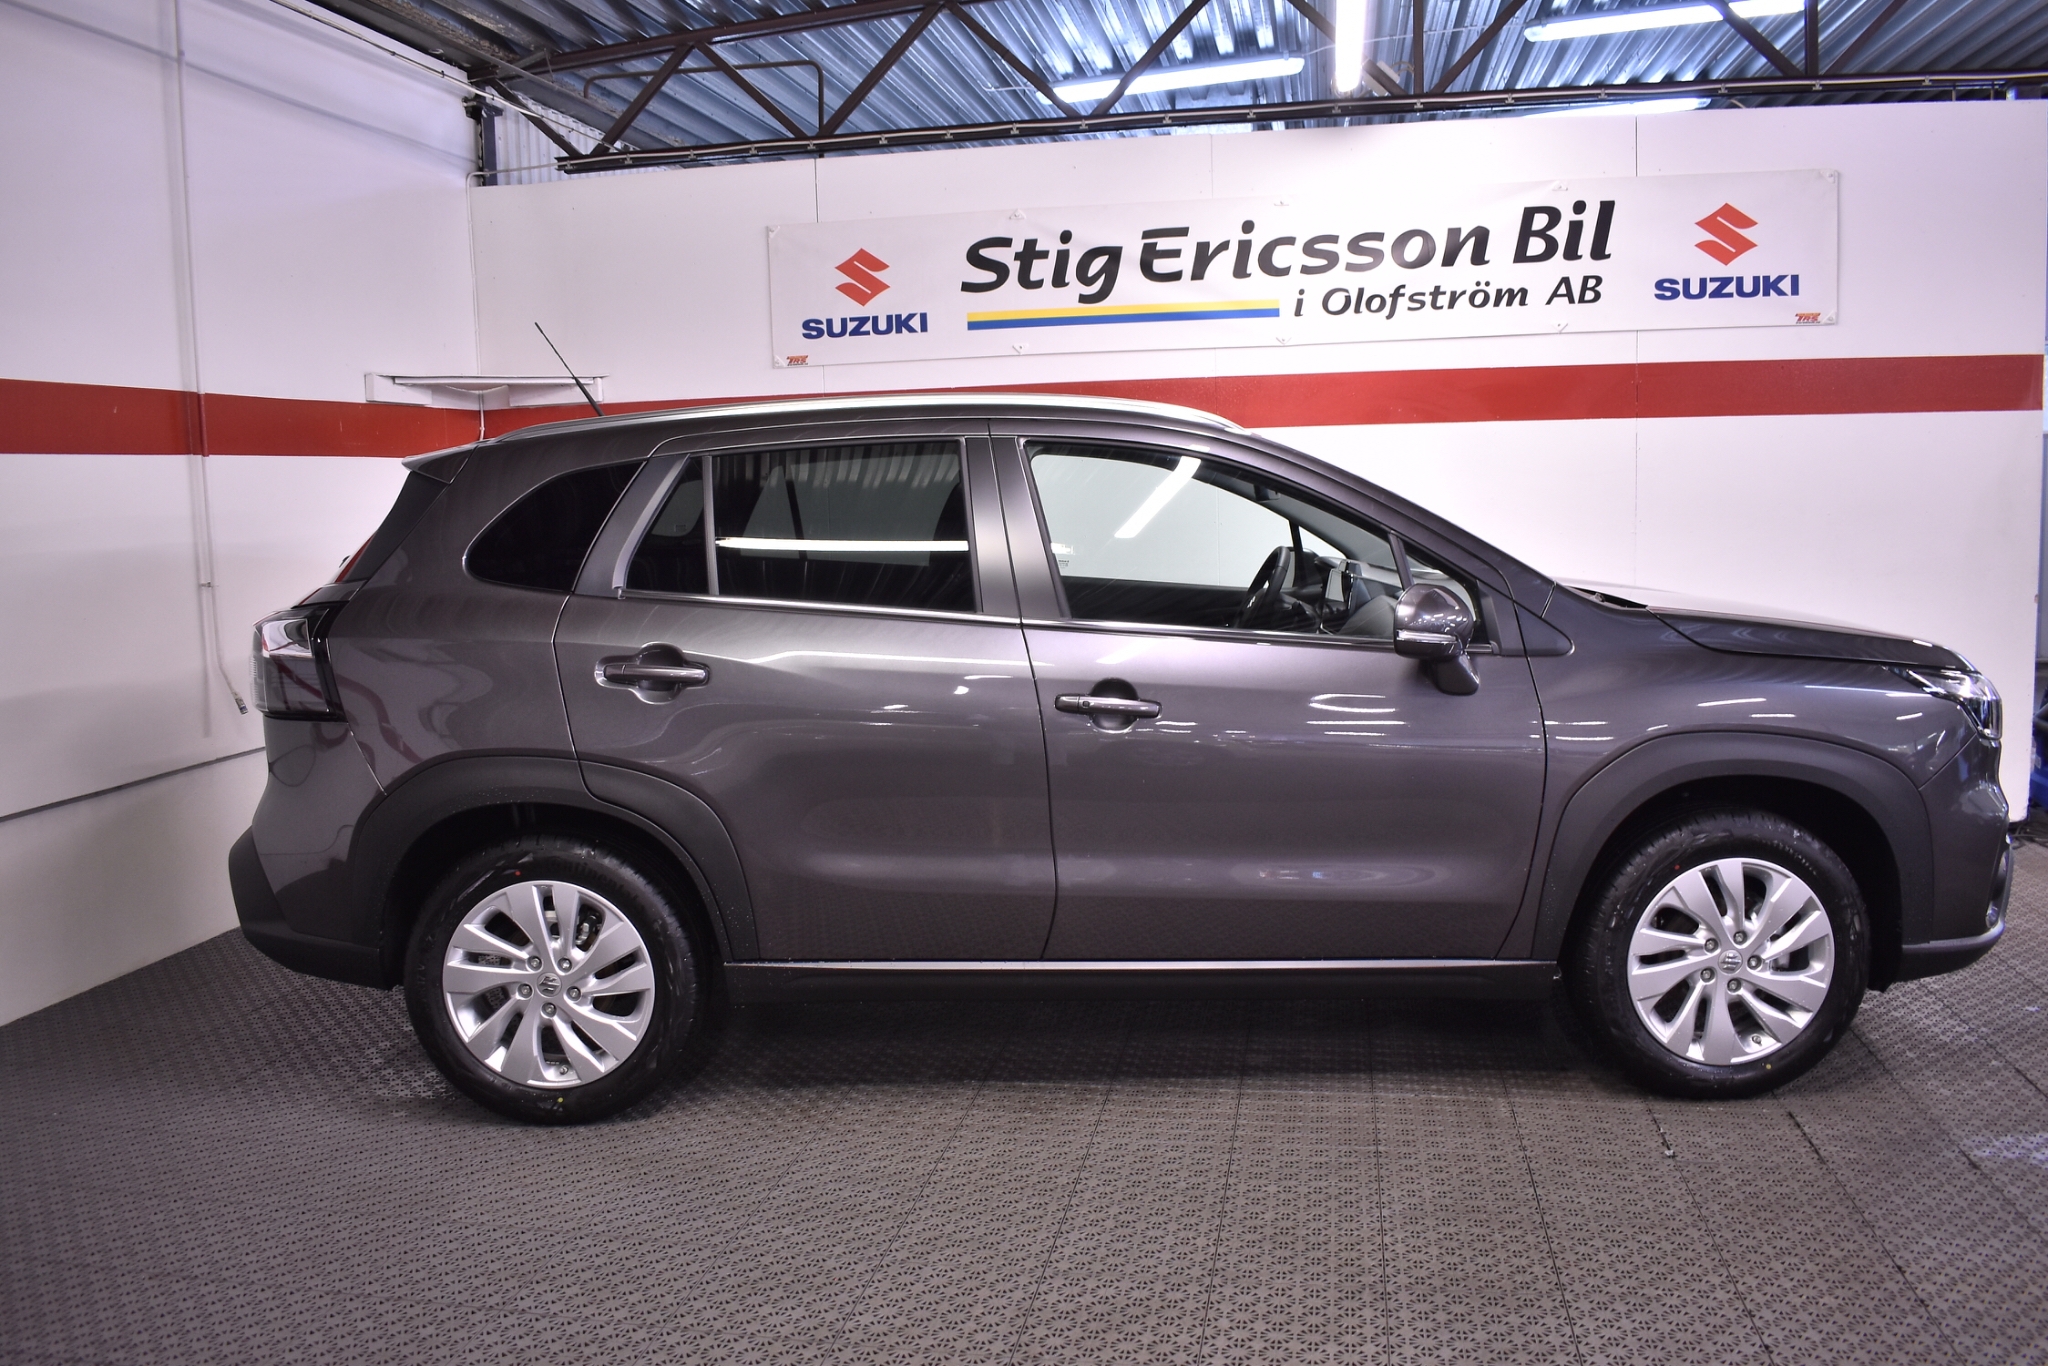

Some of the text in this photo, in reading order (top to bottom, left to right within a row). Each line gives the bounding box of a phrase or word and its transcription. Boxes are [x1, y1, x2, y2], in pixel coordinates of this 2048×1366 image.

[960, 199, 1616, 305] Stig Ericsson Bil
[1294, 274, 1603, 321] i Olofström AB
[1654, 274, 1800, 301] SUZUKI
[801, 312, 930, 340] SUZUKI
